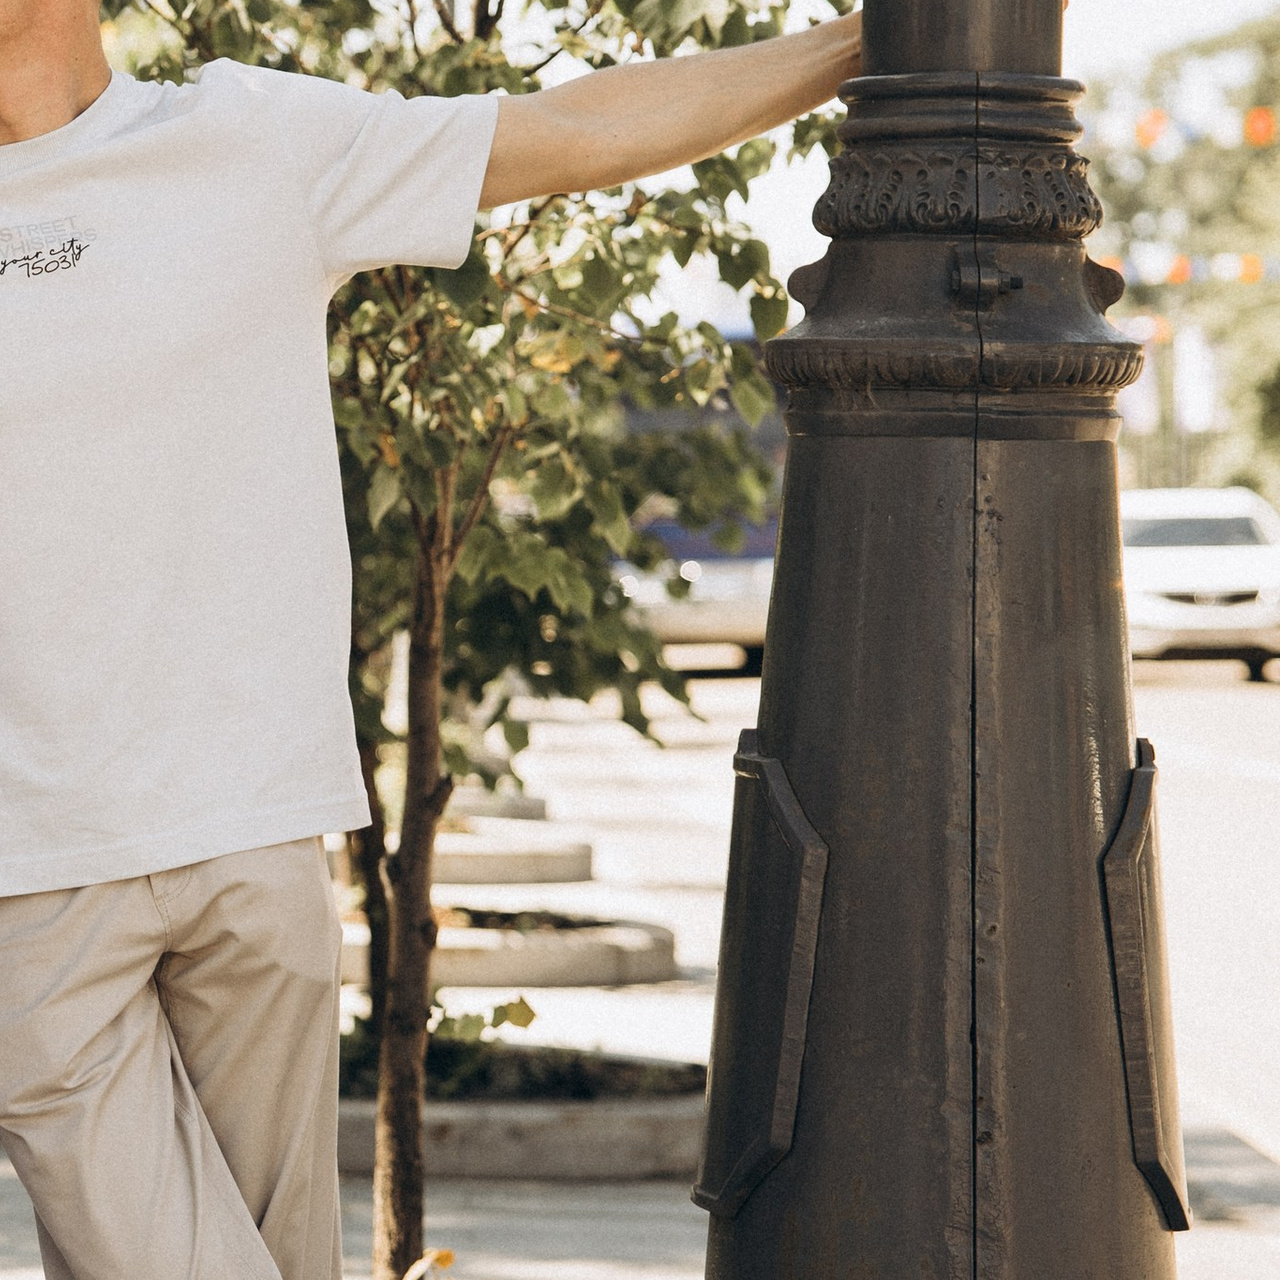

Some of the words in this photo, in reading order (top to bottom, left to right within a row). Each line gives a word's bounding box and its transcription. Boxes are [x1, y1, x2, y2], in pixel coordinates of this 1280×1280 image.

[0, 215, 78, 242] STREET
[0, 251, 43, 275] your
[49, 237, 90, 261] city
